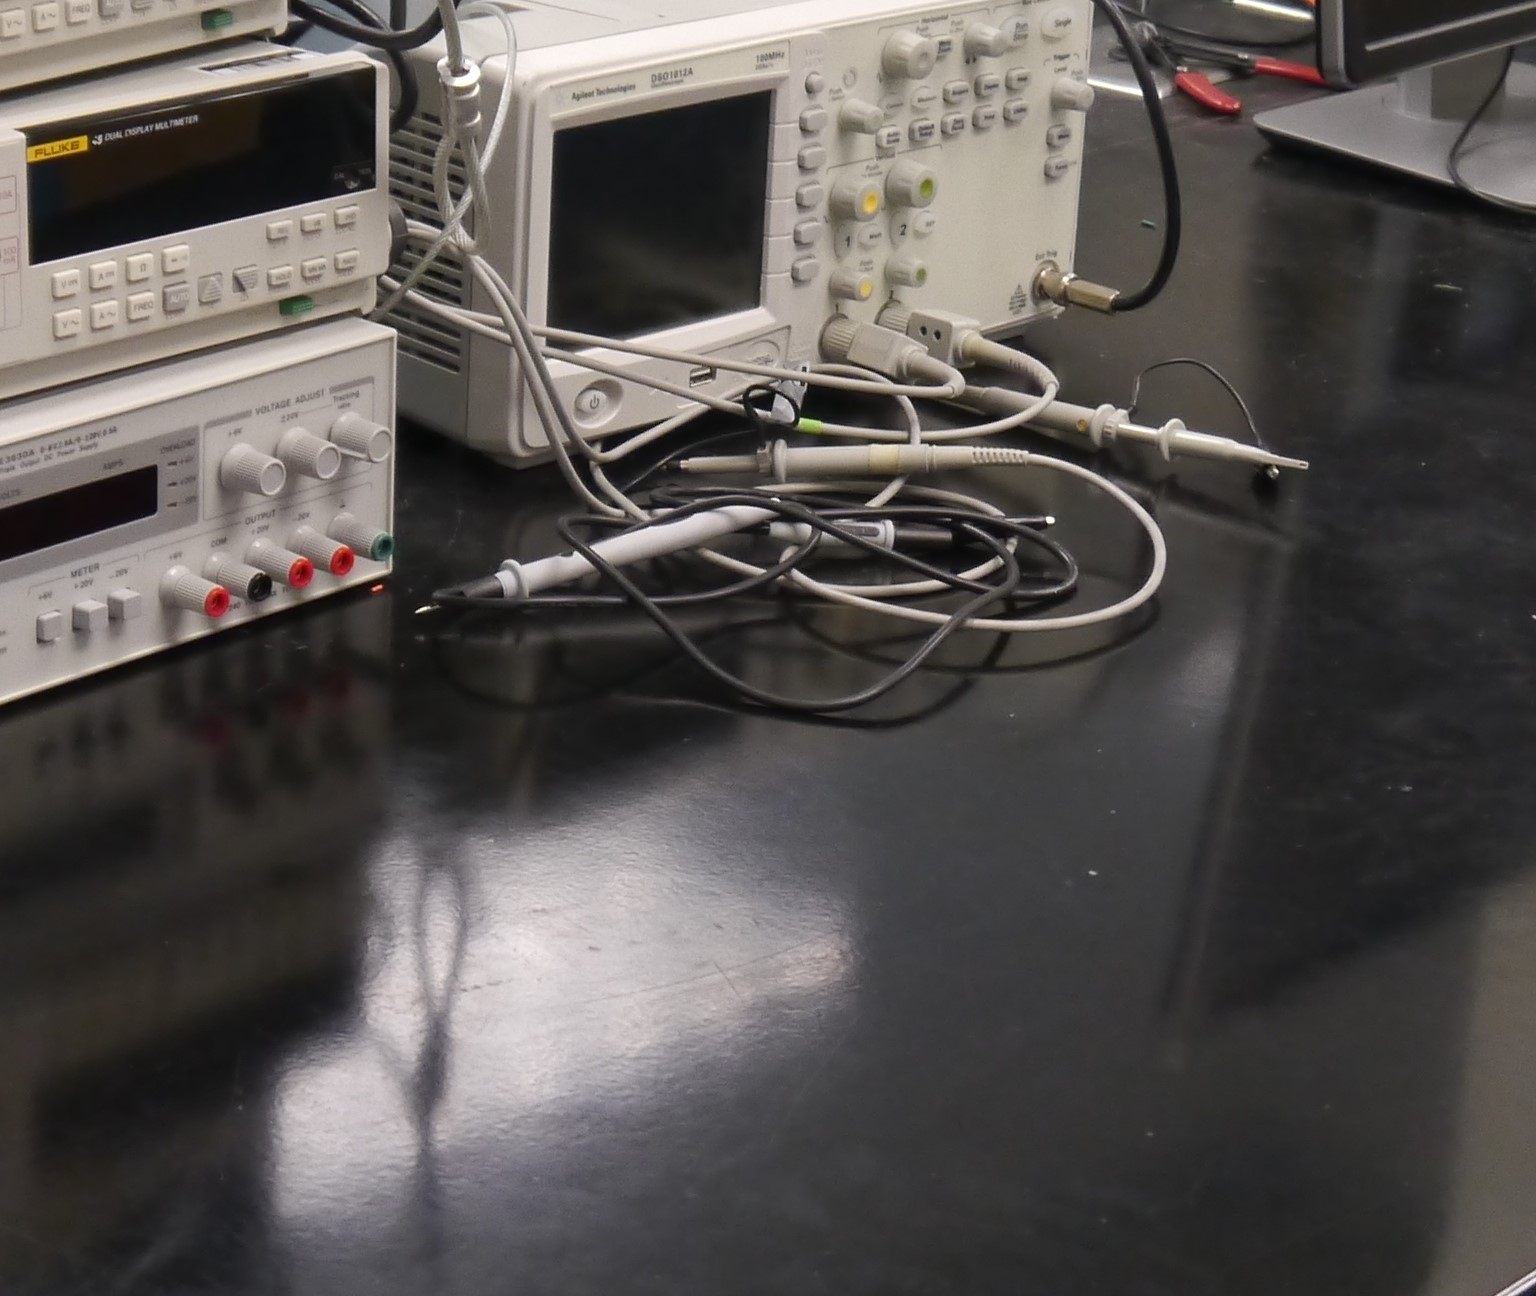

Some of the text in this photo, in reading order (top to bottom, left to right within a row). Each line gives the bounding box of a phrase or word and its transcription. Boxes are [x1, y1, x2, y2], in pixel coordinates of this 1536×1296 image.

[921, 14, 949, 24] Horizontal
[1015, 20, 1029, 30] Run
[1054, 17, 1072, 29] Single
[1014, 31, 1029, 42] Stop
[571, 82, 636, 102] Agilent Technologies
[104, 114, 200, 142] DUAL DISPLAY MULTIMETER
[34, 140, 80, 158] FLUKE
[866, 164, 879, 172] Push
[900, 223, 907, 237] 2
[845, 235, 851, 248] 1
[275, 270, 293, 281] HOLD
[170, 292, 190, 305] AUTO
[133, 300, 154, 312] FREQ
[255, 389, 325, 416] VOLTAGE ADJUST
[332, 389, 360, 404] Tracking
[102, 459, 125, 471] AMPS
[244, 509, 277, 525] OUTPUT
[210, 536, 227, 548] COM
[70, 562, 100, 578] METER
